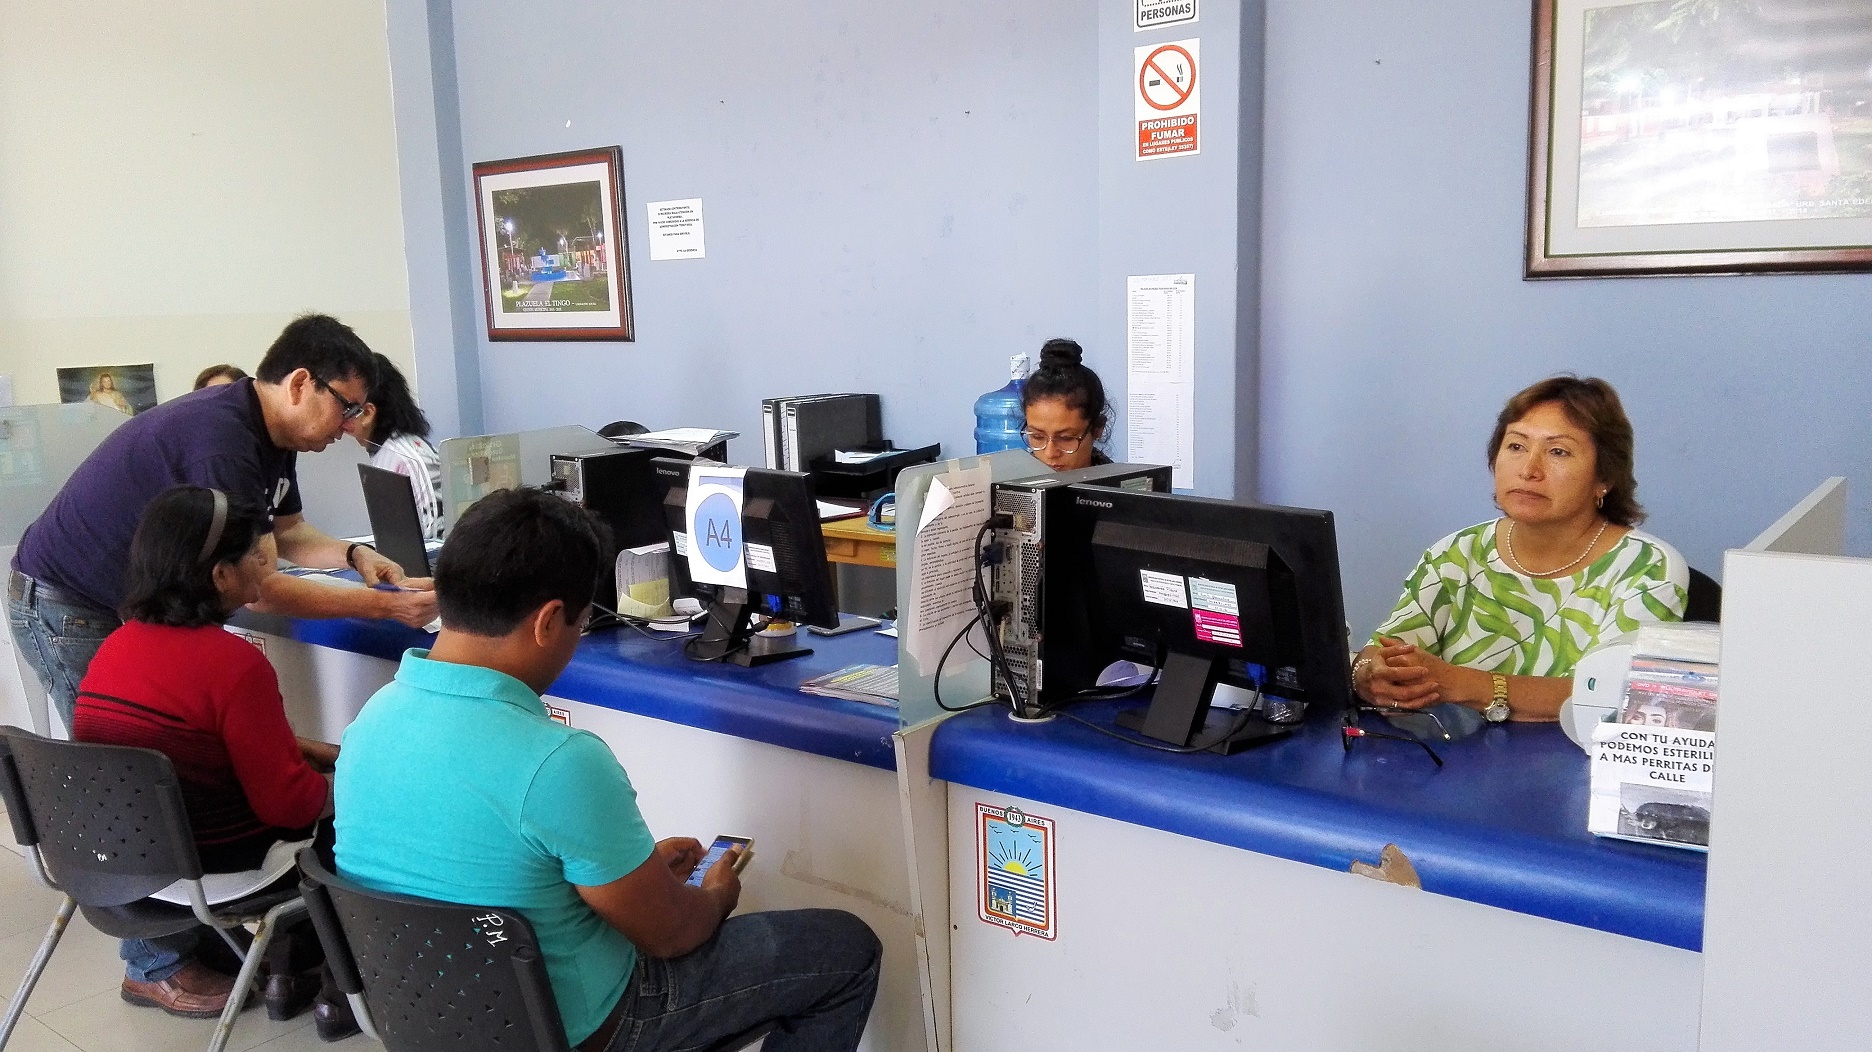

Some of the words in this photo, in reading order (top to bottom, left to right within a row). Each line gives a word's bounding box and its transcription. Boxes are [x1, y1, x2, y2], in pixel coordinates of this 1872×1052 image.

[1140, 3, 1192, 21] PERSONAS
[1141, 116, 1195, 131] PROHIBIDO
[1151, 128, 1185, 140] FUMAR
[1820, 199, 1849, 207] SANTA
[515, 300, 543, 308] PLAZUELA
[552, 299, 571, 307] TINGO
[656, 467, 680, 477] lenovo
[1076, 496, 1113, 508] lenovo
[706, 518, 733, 549] A4
[1620, 731, 1648, 741] CON
[1652, 734, 1668, 744] TU
[1672, 737, 1715, 749] AYUDA
[1600, 741, 1659, 755] PODEMOS
[1599, 752, 1609, 762] A
[1612, 753, 1638, 765] MAS
[1642, 757, 1698, 772] PERRITAS
[1649, 771, 1686, 783] CALLE
[979, 806, 1004, 817] BUENOS
[1008, 812, 1022, 823] 1943
[1026, 817, 1046, 826] AIRES
[984, 914, 1004, 924] VICTOR
[1004, 920, 1023, 930] LARCO
[1023, 925, 1049, 937] HERRERA
